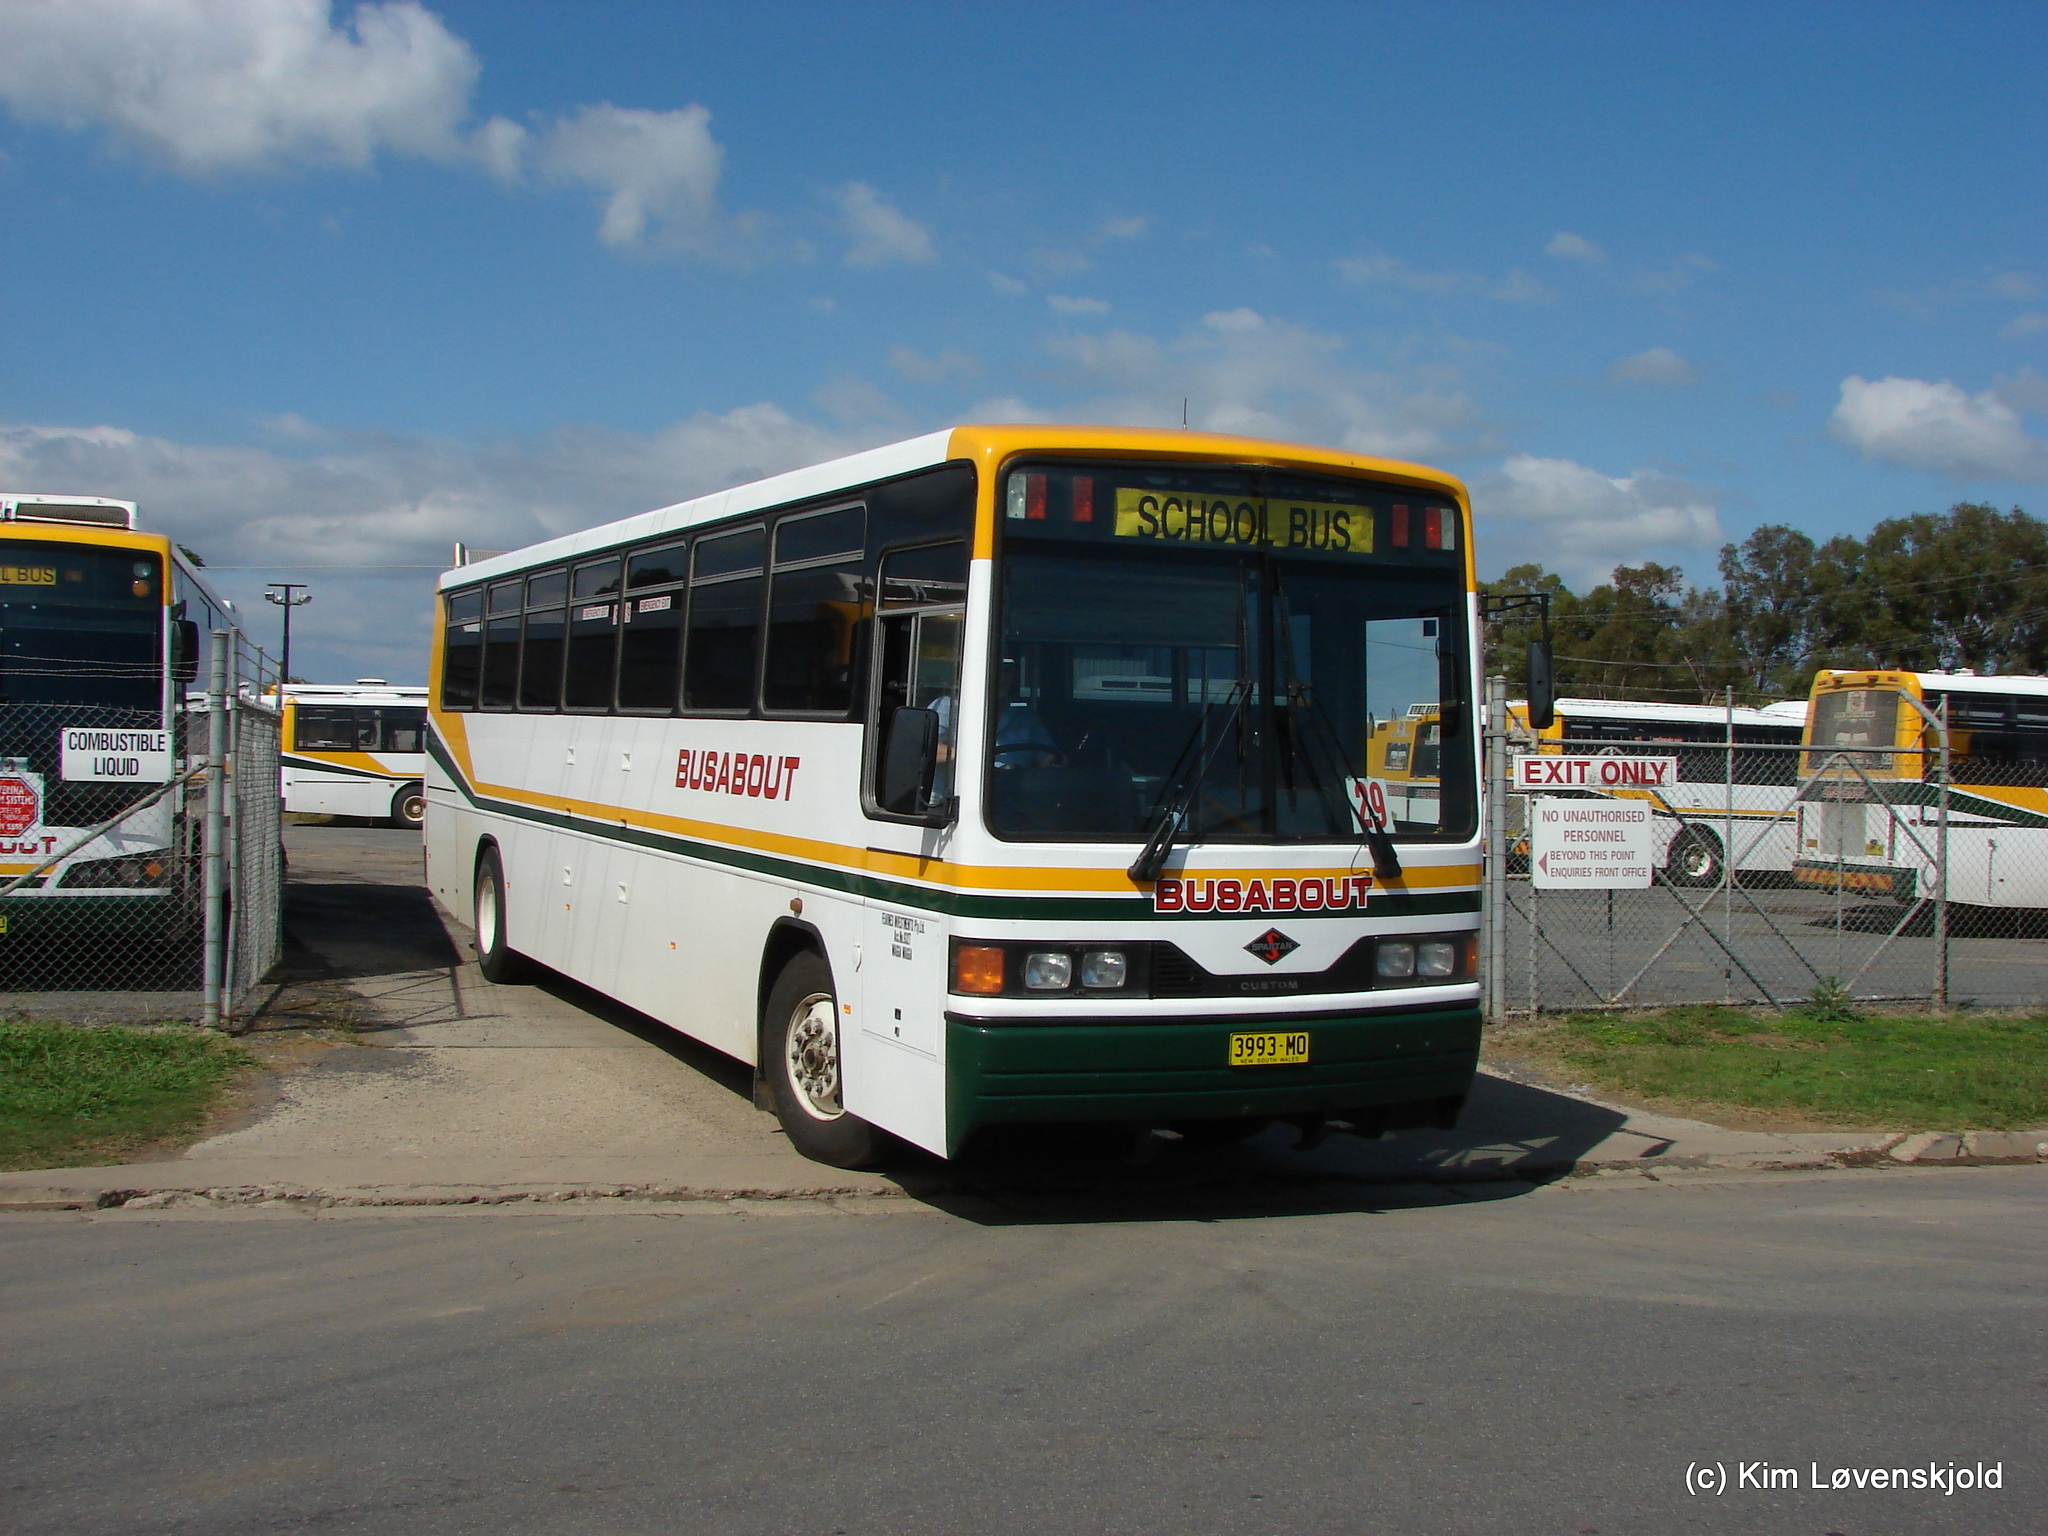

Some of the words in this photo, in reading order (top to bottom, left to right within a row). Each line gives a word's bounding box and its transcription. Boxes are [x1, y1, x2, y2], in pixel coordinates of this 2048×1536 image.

[1138, 496, 1274, 546] SCHOOL
[1289, 507, 1350, 550] BUS
[17, 567, 55, 583] BUS
[69, 732, 165, 752] COMBUSTIBLE
[94, 757, 139, 776] LIQUID
[675, 749, 800, 801] BUSABOUT
[1524, 761, 1591, 784] EXIT
[1600, 761, 1667, 784] ONLY
[1354, 782, 1387, 829] 29
[1542, 810, 1559, 823] NO
[1563, 810, 1645, 823] UNAUTHORISED
[1563, 830, 1626, 842] PERSONNEL
[1550, 850, 1586, 861] BEYOND
[1589, 850, 1608, 861] THIS
[1611, 850, 1635, 861] POINT
[1550, 867, 1592, 879] ENQUIRIES
[1595, 867, 1619, 877] FRONT
[1622, 867, 1647, 877] OFFICE
[1155, 877, 1373, 912] BUSABOUT
[1251, 941, 1293, 952] SPARTAN
[1240, 980, 1299, 991] CUSTOM
